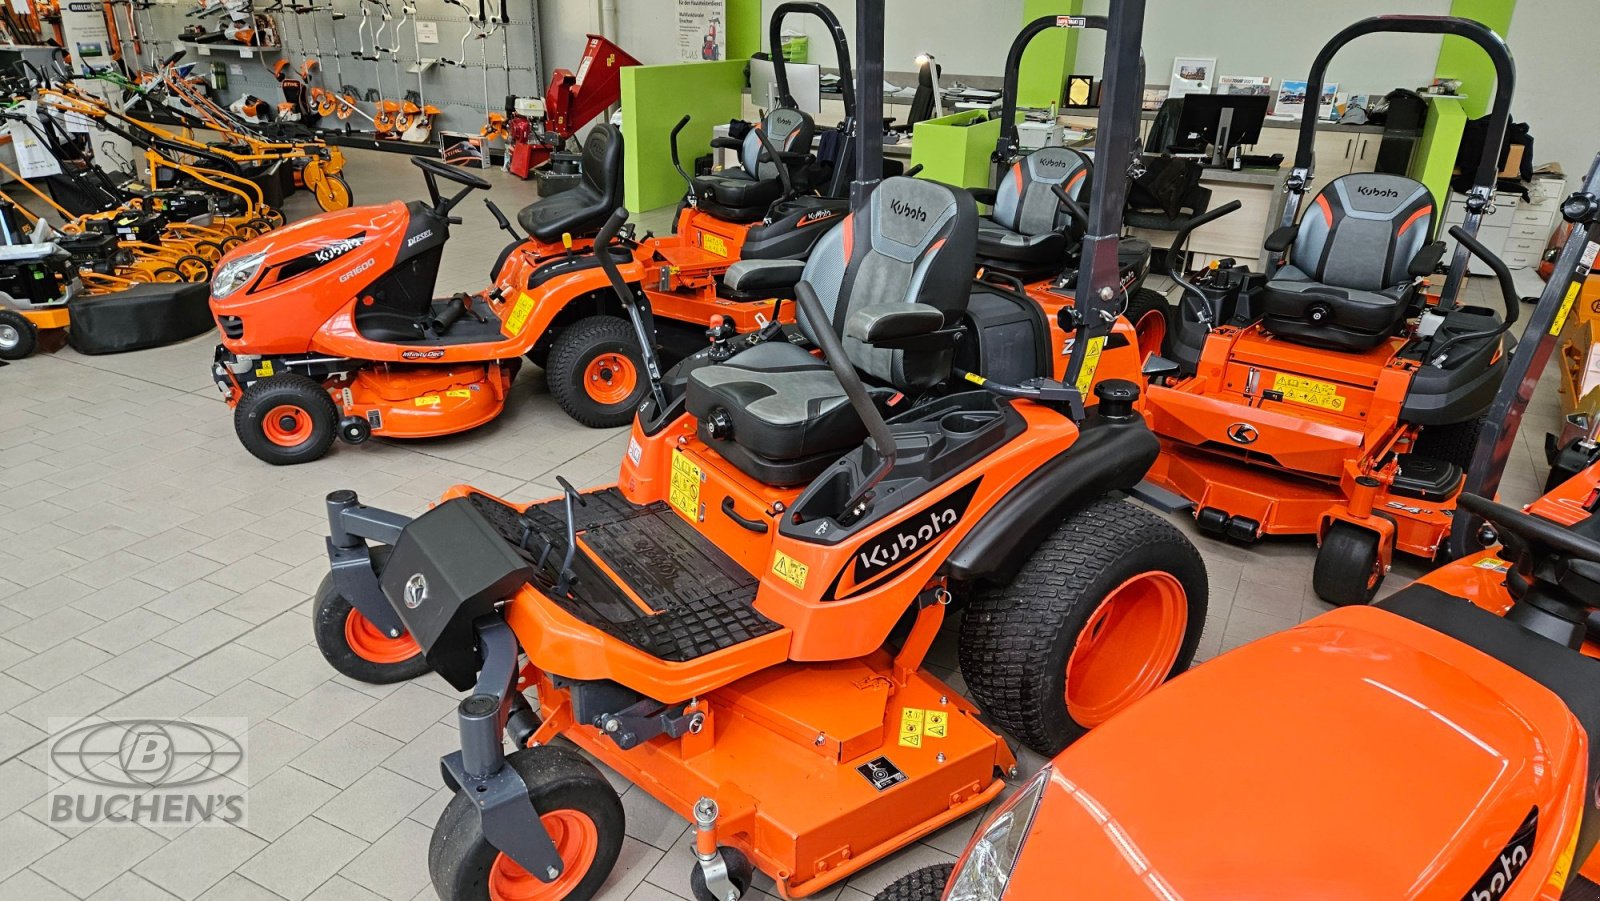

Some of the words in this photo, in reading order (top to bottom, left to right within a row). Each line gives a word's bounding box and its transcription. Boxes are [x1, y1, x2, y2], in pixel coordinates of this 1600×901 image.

[1040, 158, 1067, 168] Kubota
[1357, 186, 1398, 198] Kubota
[890, 199, 927, 222] Kubota
[315, 236, 364, 262] Kubota
[407, 229, 433, 248] DIESEL
[339, 257, 376, 283] GR1600
[860, 508, 957, 569] Kubota
